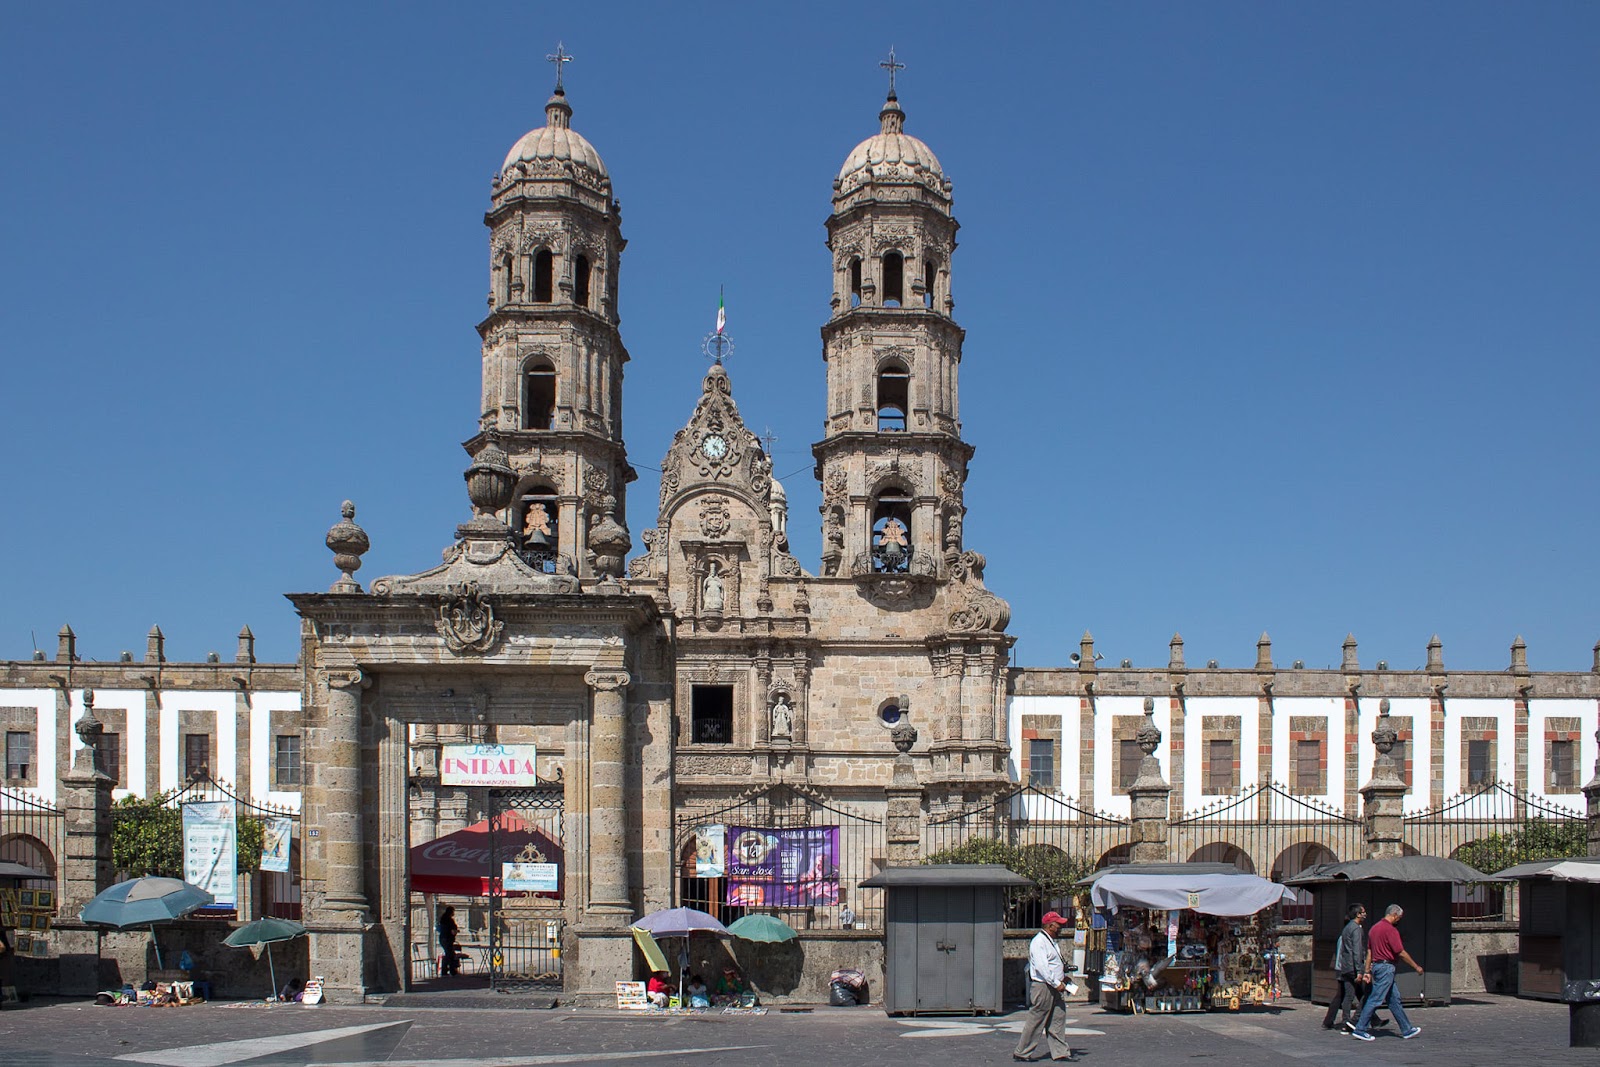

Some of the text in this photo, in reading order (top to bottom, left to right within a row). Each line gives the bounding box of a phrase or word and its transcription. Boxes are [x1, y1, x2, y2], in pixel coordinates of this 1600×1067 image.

[444, 758, 534, 775] ENTRADA
[731, 866, 750, 875] San
[752, 865, 775, 876] José
